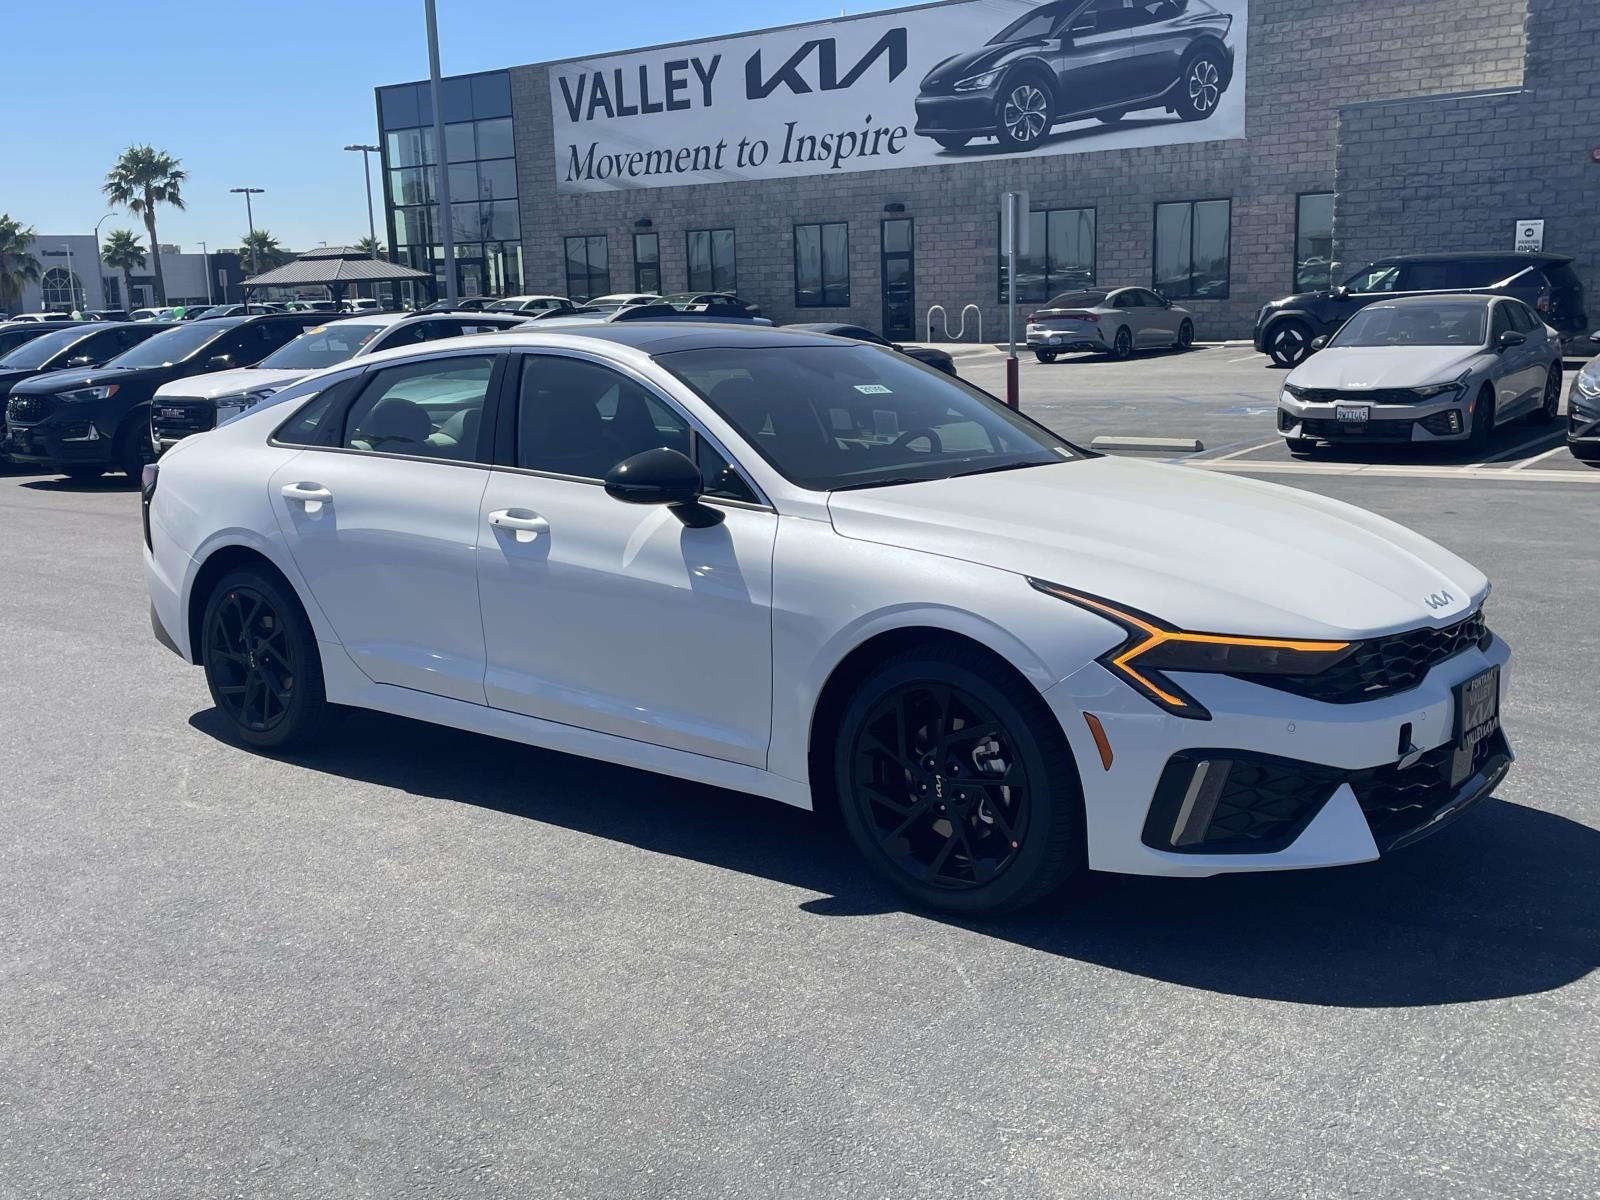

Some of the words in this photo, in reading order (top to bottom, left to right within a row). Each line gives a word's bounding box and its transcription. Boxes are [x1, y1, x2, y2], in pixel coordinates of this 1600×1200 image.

[558, 54, 722, 122] VALLEY
[565, 138, 728, 182] Movement
[737, 136, 769, 168] to
[778, 114, 908, 169] Inspire
